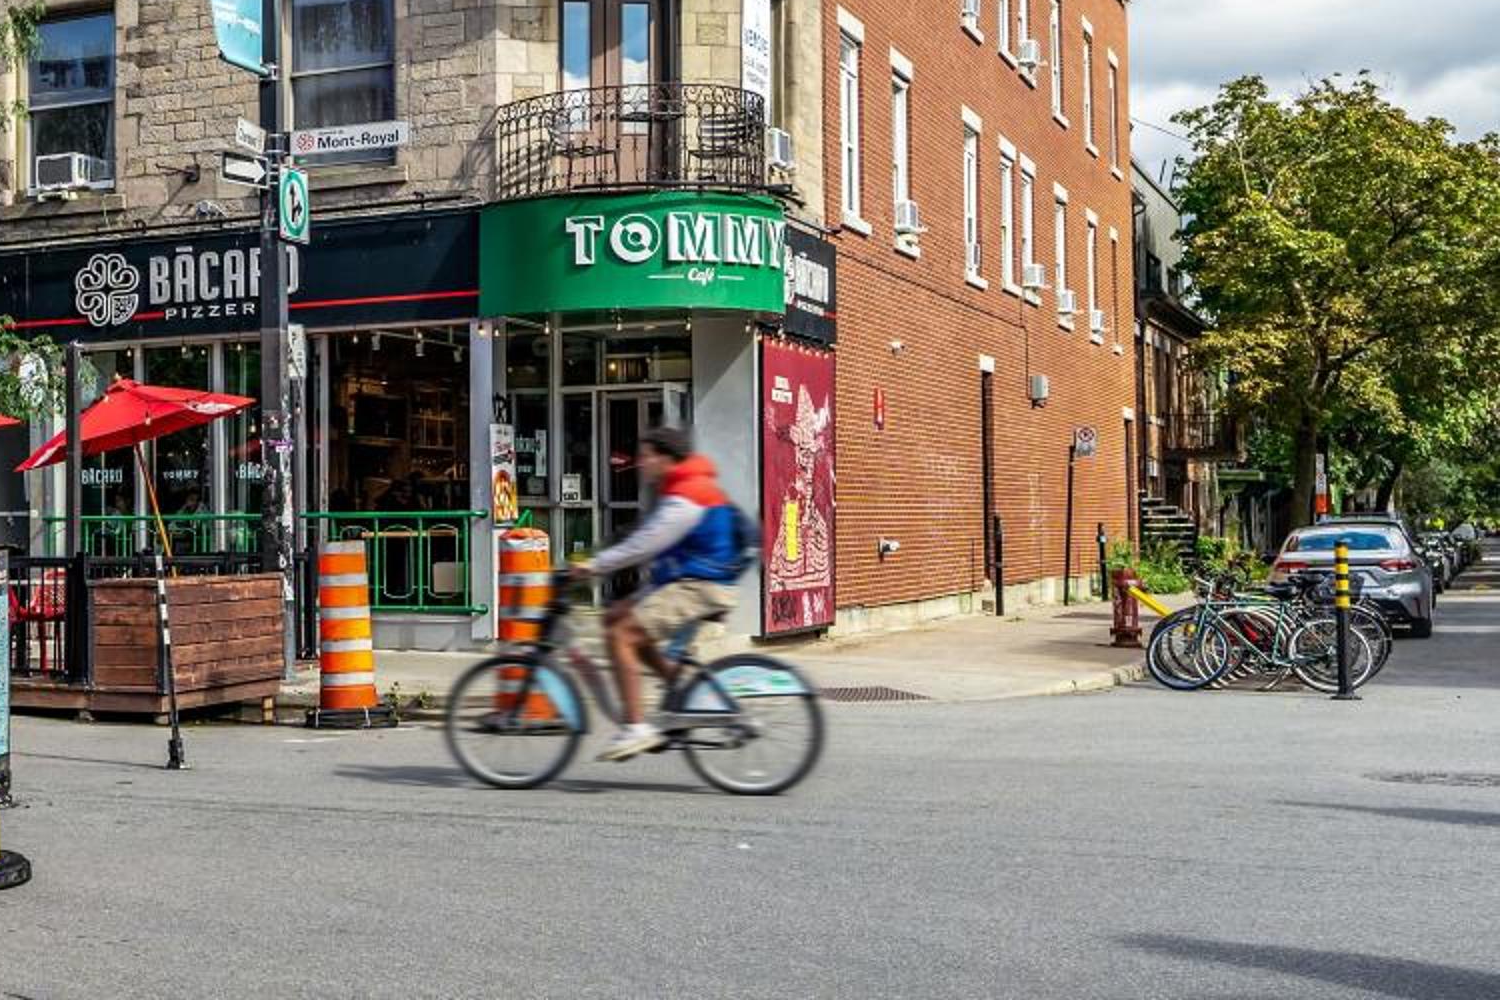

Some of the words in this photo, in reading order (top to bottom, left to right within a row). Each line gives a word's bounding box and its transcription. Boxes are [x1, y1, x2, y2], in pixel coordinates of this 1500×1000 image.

[317, 130, 399, 149] Mont-Royal
[566, 212, 786, 269] TOMMY
[687, 267, 715, 286] Café
[165, 303, 256, 320] PIZZER
